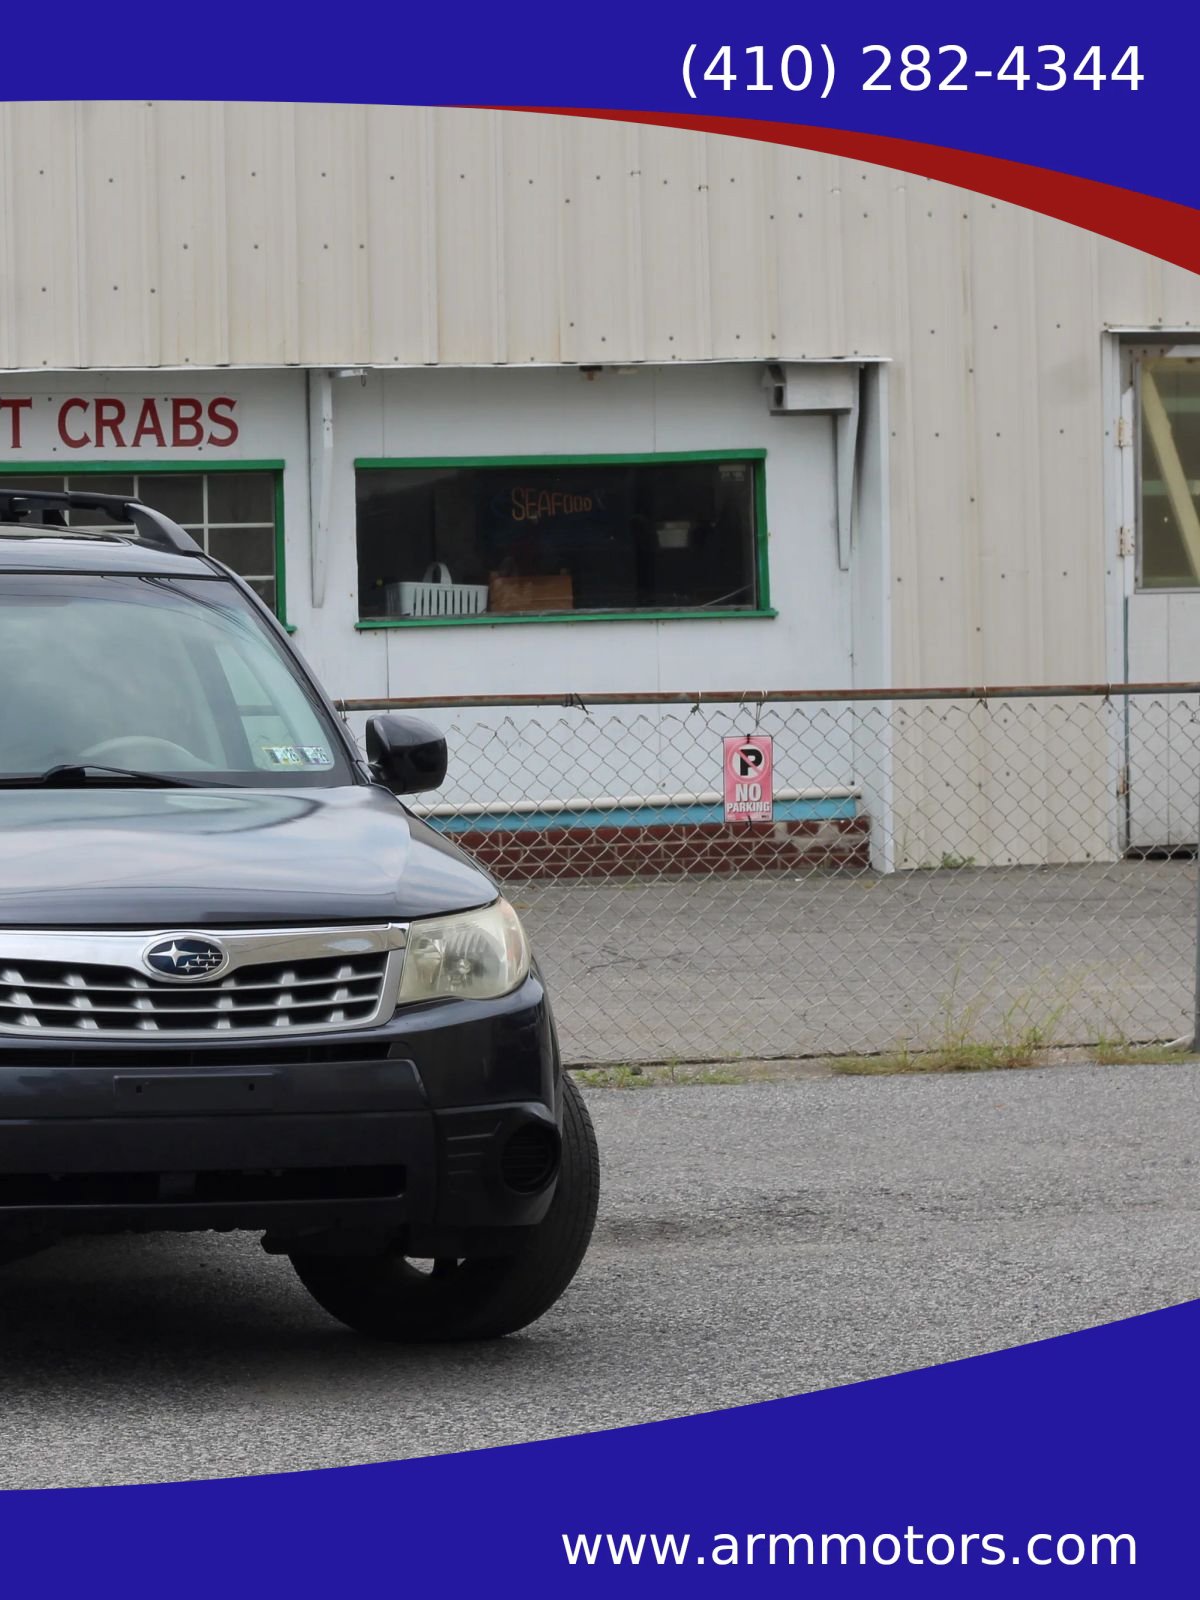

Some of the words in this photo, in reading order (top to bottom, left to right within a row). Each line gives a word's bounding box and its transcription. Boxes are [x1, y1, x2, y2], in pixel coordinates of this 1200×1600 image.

[58, 397, 239, 449] CRABS
[511, 486, 592, 520] SEAFOOD
[735, 783, 762, 802] NO
[727, 801, 770, 813] PARKING
